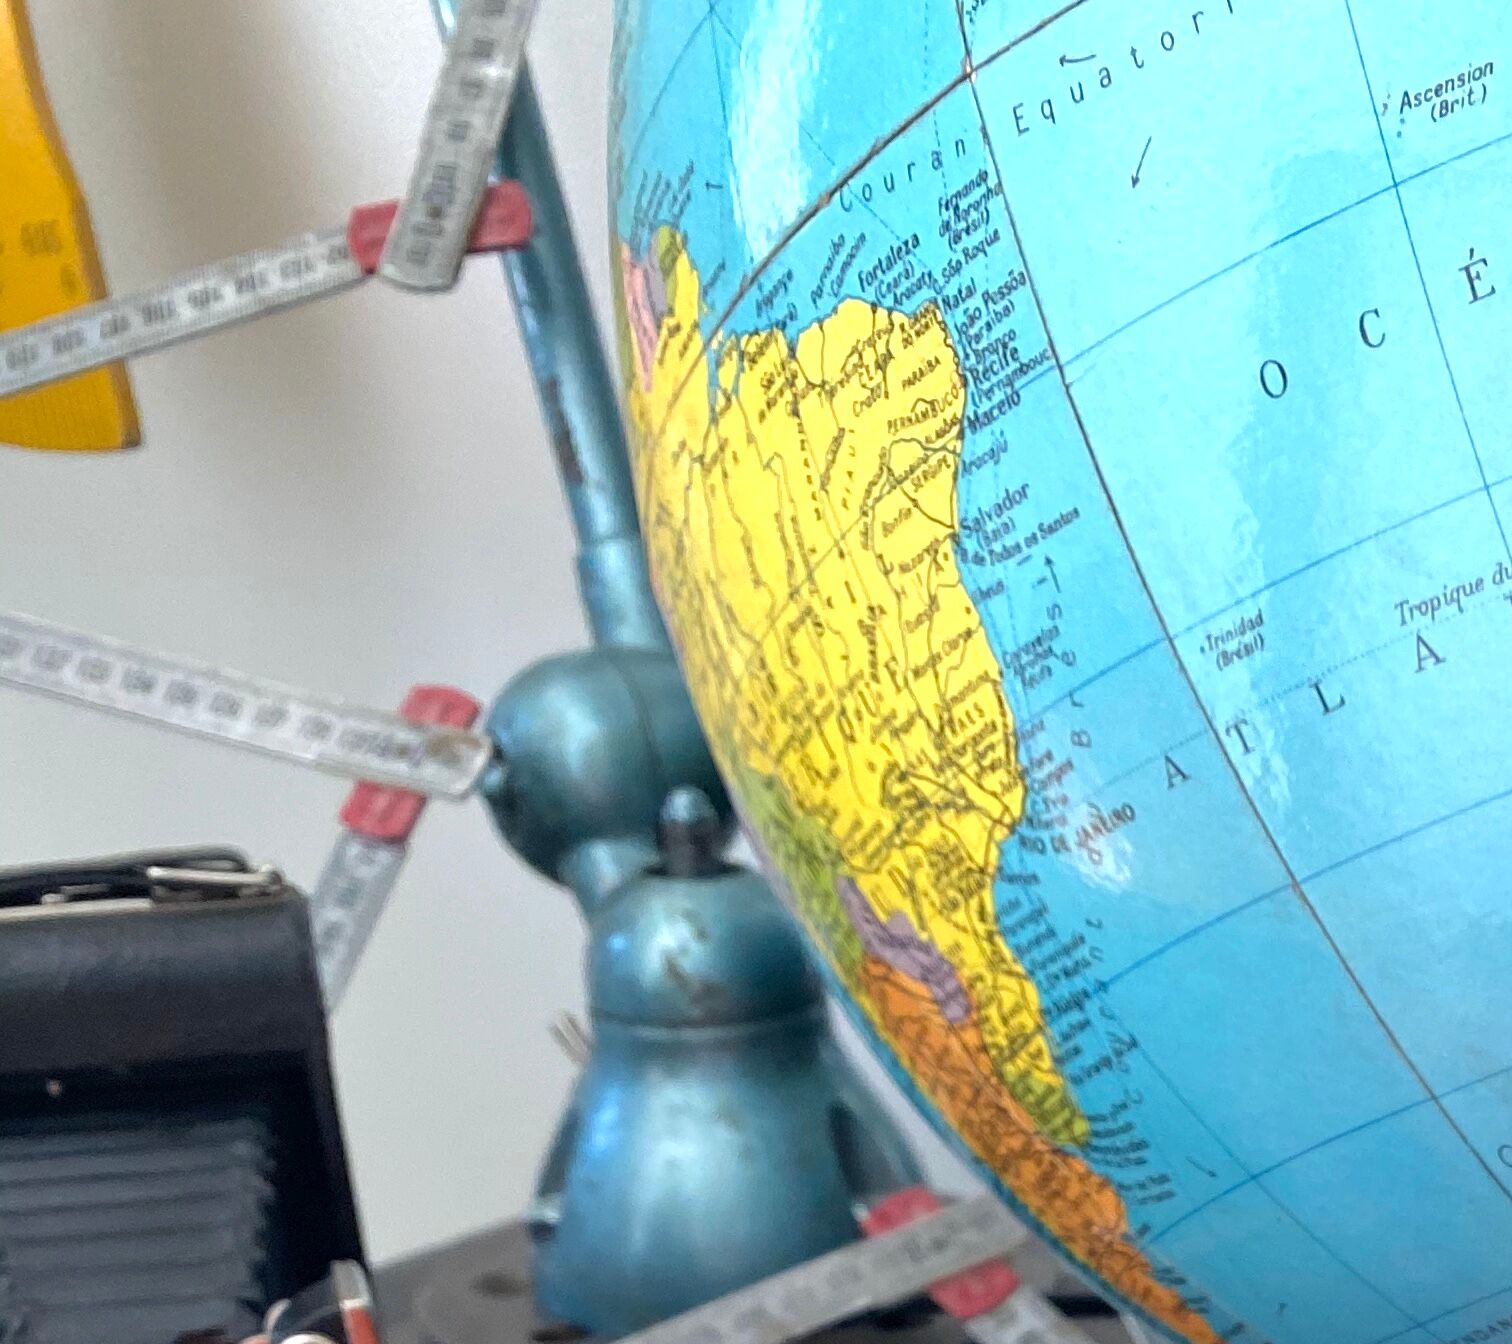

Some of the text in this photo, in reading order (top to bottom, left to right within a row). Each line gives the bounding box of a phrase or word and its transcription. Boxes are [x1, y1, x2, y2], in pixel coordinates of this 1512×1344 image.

[1401, 62, 1494, 113] Ascension
[858, 233, 921, 292] Fortaleza
[961, 483, 1029, 534] Salvador
[1394, 577, 1484, 627] Tropique
[1205, 610, 1264, 653] Trinidad
